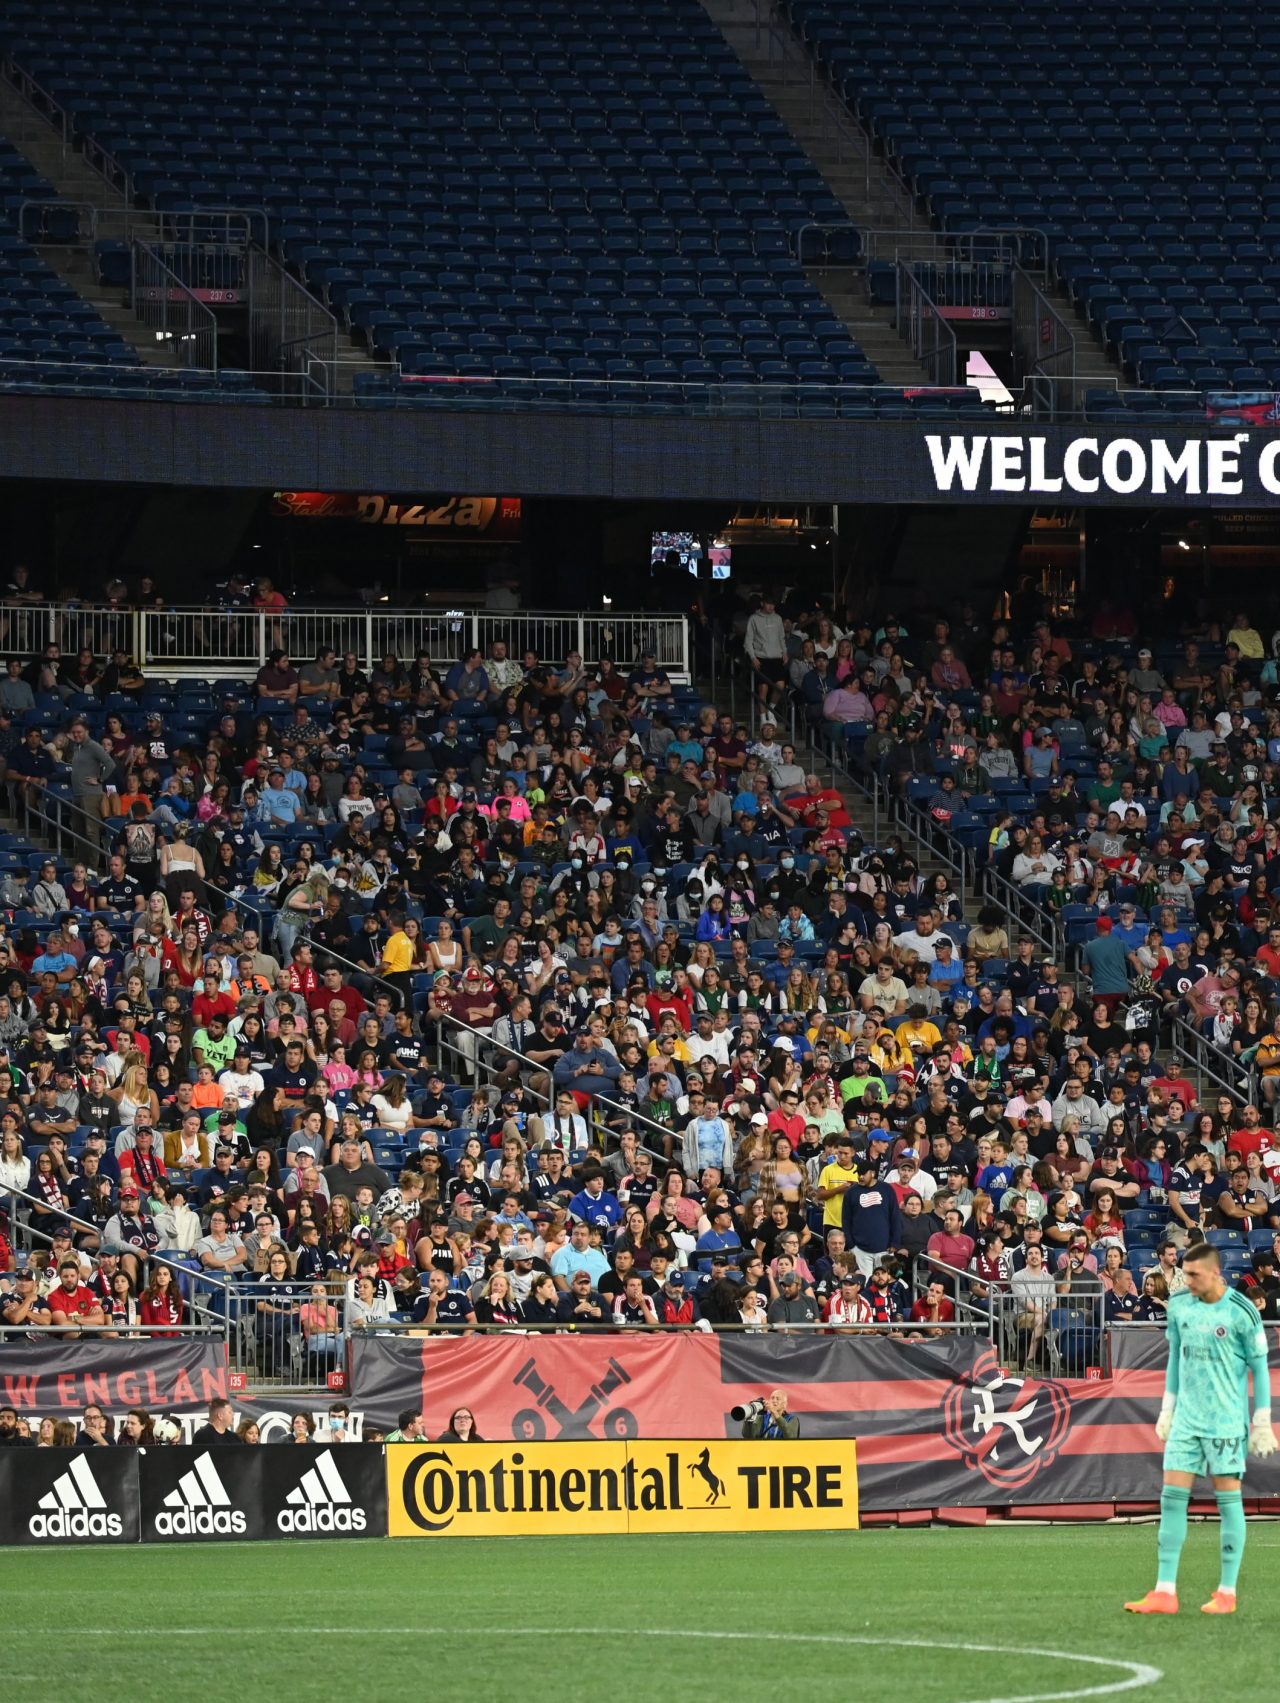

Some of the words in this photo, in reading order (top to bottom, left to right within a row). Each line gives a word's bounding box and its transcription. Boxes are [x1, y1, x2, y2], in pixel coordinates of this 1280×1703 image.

[210, 290, 222, 300] 237
[972, 307, 985, 318] 238
[925, 436, 1243, 494] WELCOME
[206, 1048, 227, 1061] YETI
[401, 1047, 419, 1057] UHC
[432, 1248, 453, 1258] PINK
[229, 1376, 242, 1387] 135
[332, 1375, 344, 1386] 136
[1090, 1369, 1101, 1380] 137
[57, 1367, 228, 1408] ENGLAN
[614, 1416, 628, 1436] 6
[1212, 1438, 1240, 1456] 99
[402, 1449, 684, 1531] Continental
[737, 1465, 844, 1509] TIRE
[28, 1506, 123, 1537] adidas
[155, 1504, 247, 1535] adidas
[277, 1502, 367, 1532] adidas
